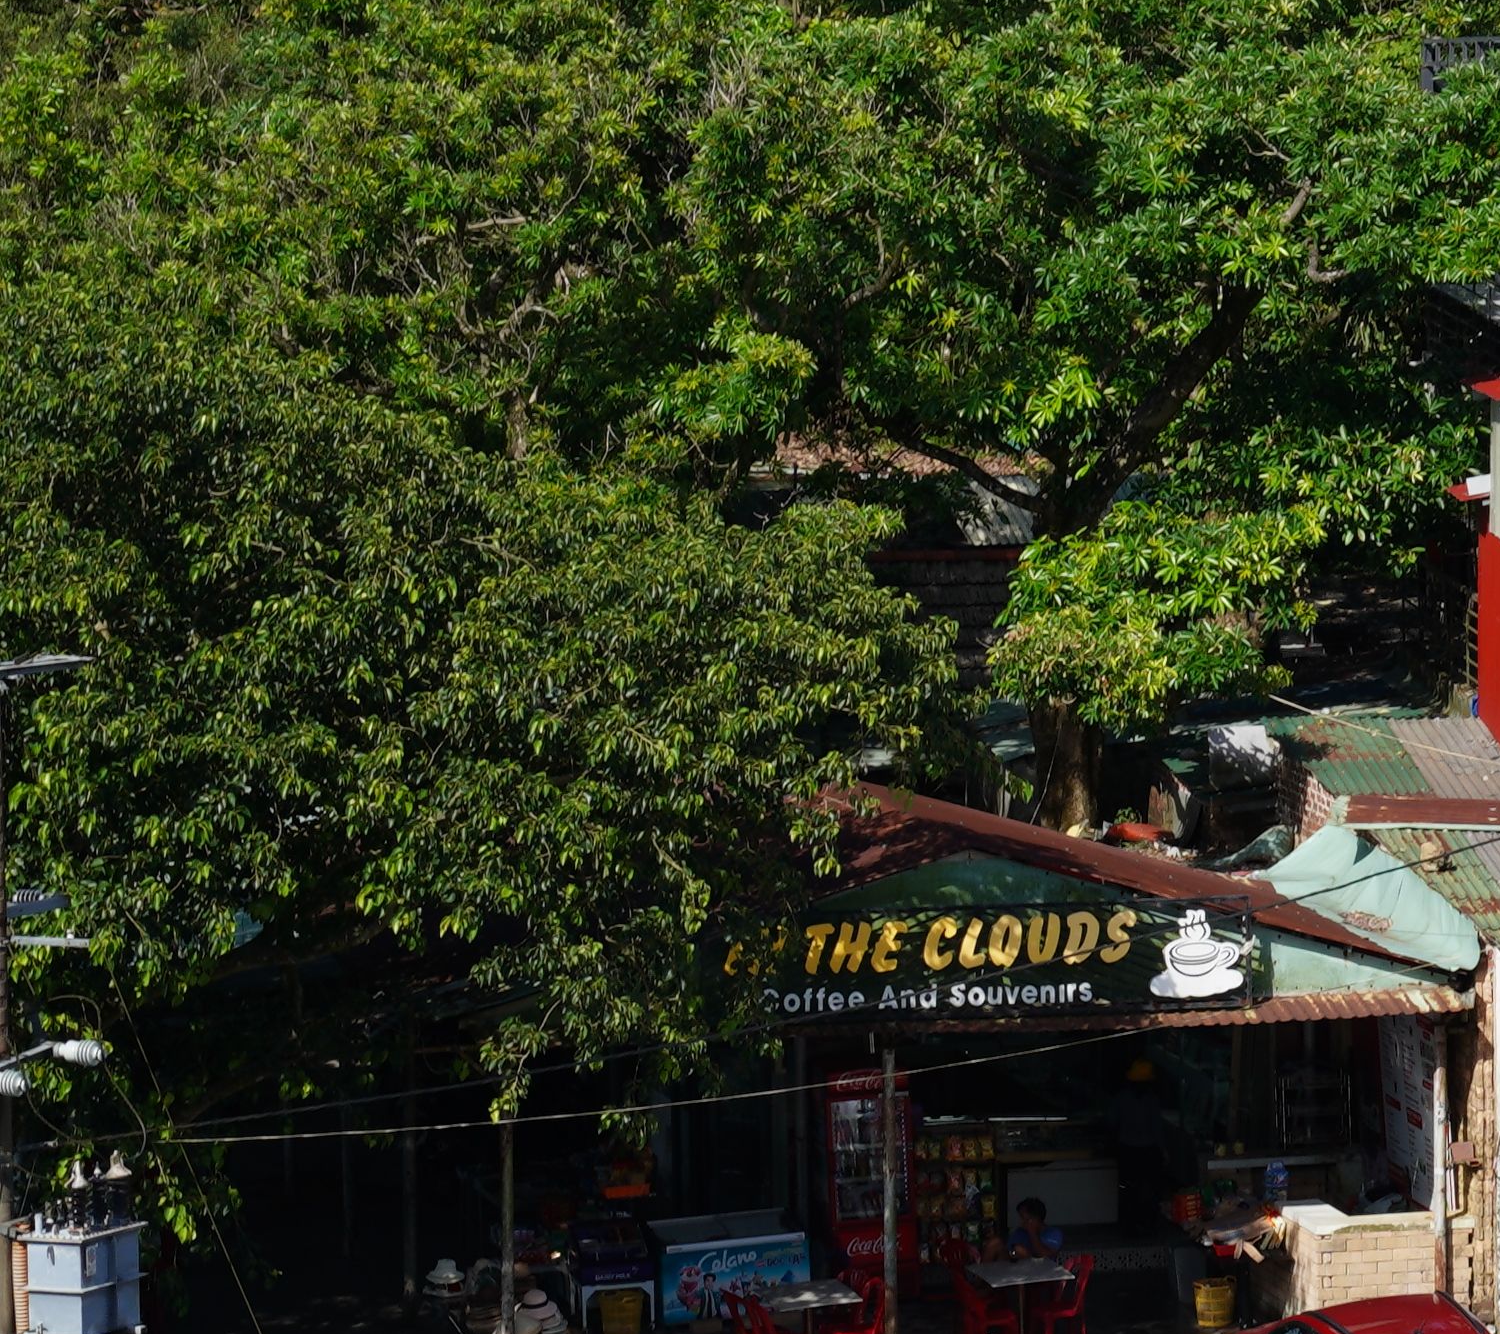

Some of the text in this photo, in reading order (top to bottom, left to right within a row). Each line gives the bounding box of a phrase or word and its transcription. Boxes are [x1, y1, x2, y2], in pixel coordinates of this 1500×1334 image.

[802, 921, 908, 977] THE
[922, 904, 1138, 971] CLOUDS
[878, 984, 929, 1011] And
[937, 981, 1094, 1009] Souvenirs
